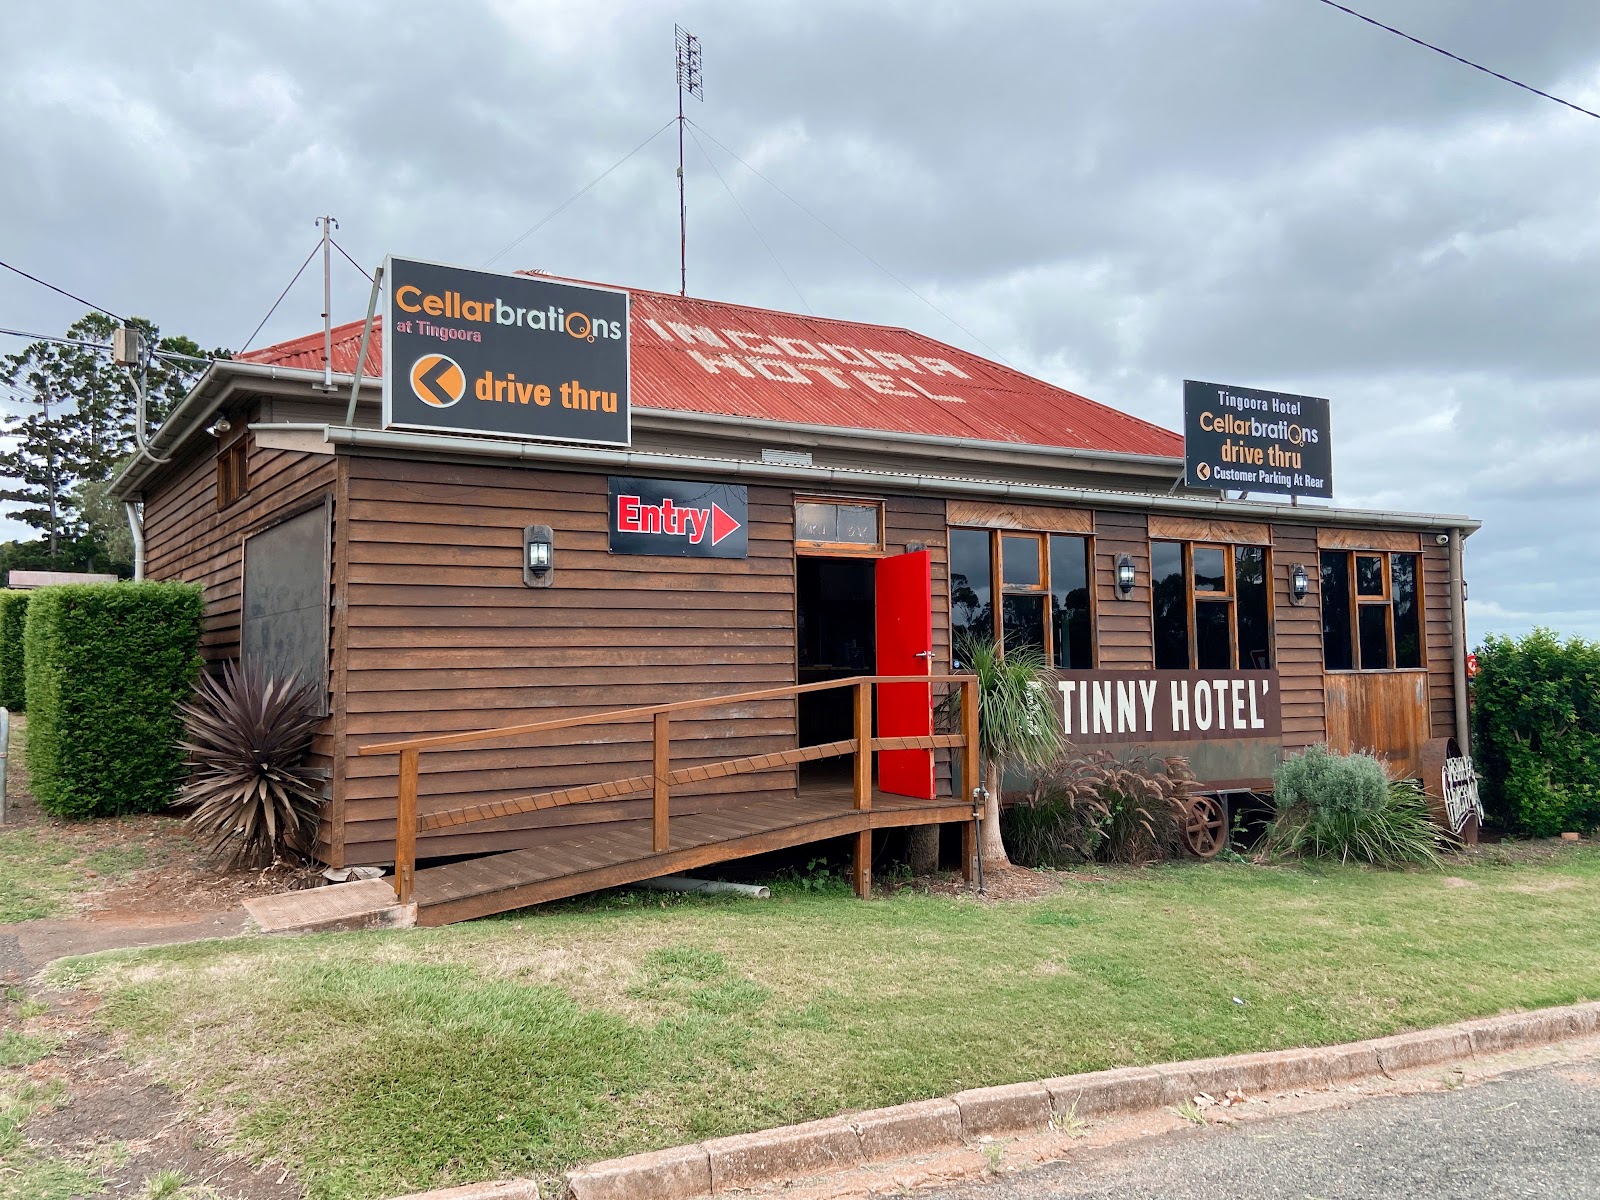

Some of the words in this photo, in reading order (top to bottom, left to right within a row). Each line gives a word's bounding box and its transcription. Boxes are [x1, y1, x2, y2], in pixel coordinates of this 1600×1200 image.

[395, 285, 622, 342] Cellarbrations
[396, 319, 412, 333] at
[416, 319, 482, 343] Tingoora
[475, 370, 551, 407] drive
[559, 380, 618, 413] thru
[686, 349, 967, 403] HOTEL
[1217, 390, 1268, 411] Tingoora
[1272, 398, 1301, 415] Hotel
[1199, 411, 1319, 446] Cellarbrations
[1221, 438, 1264, 465] drive
[1268, 444, 1302, 469] thru
[1213, 465, 1257, 482] Customer
[1259, 469, 1291, 488] Parking
[1293, 473, 1303, 486] At
[1305, 474, 1324, 488] Rear
[617, 494, 710, 545] Entry
[1058, 679, 1157, 735] TINNY
